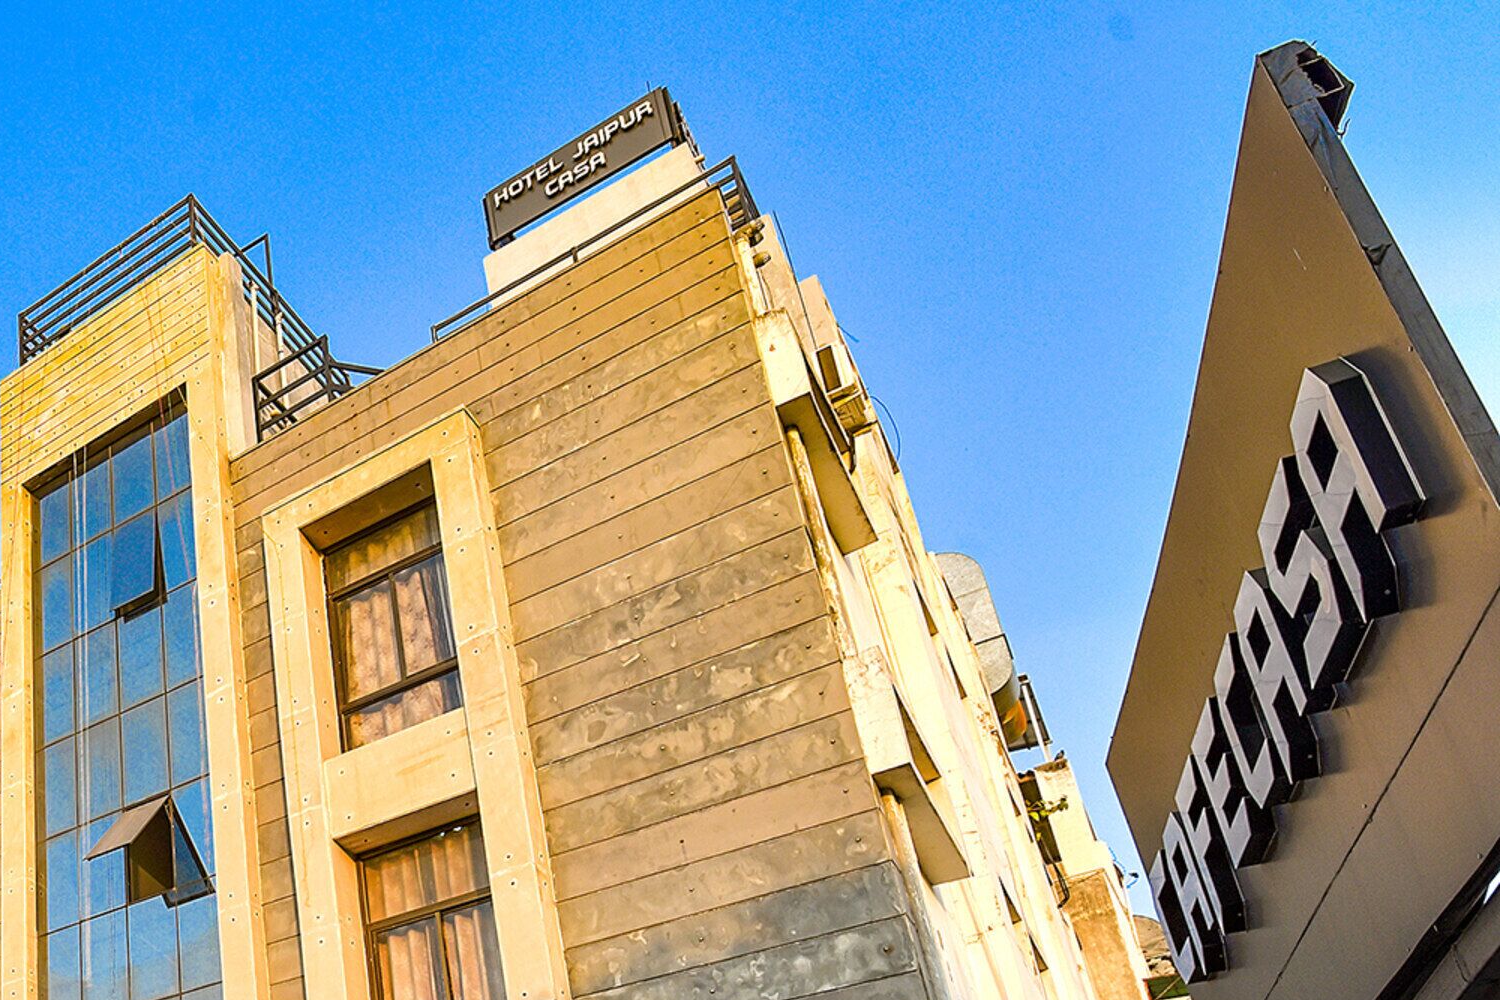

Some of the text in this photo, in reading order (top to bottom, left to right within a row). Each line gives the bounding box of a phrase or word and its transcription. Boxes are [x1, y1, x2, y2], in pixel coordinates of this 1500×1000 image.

[493, 100, 654, 209] HOTEL JAIPUR
[544, 151, 607, 197] CASA
